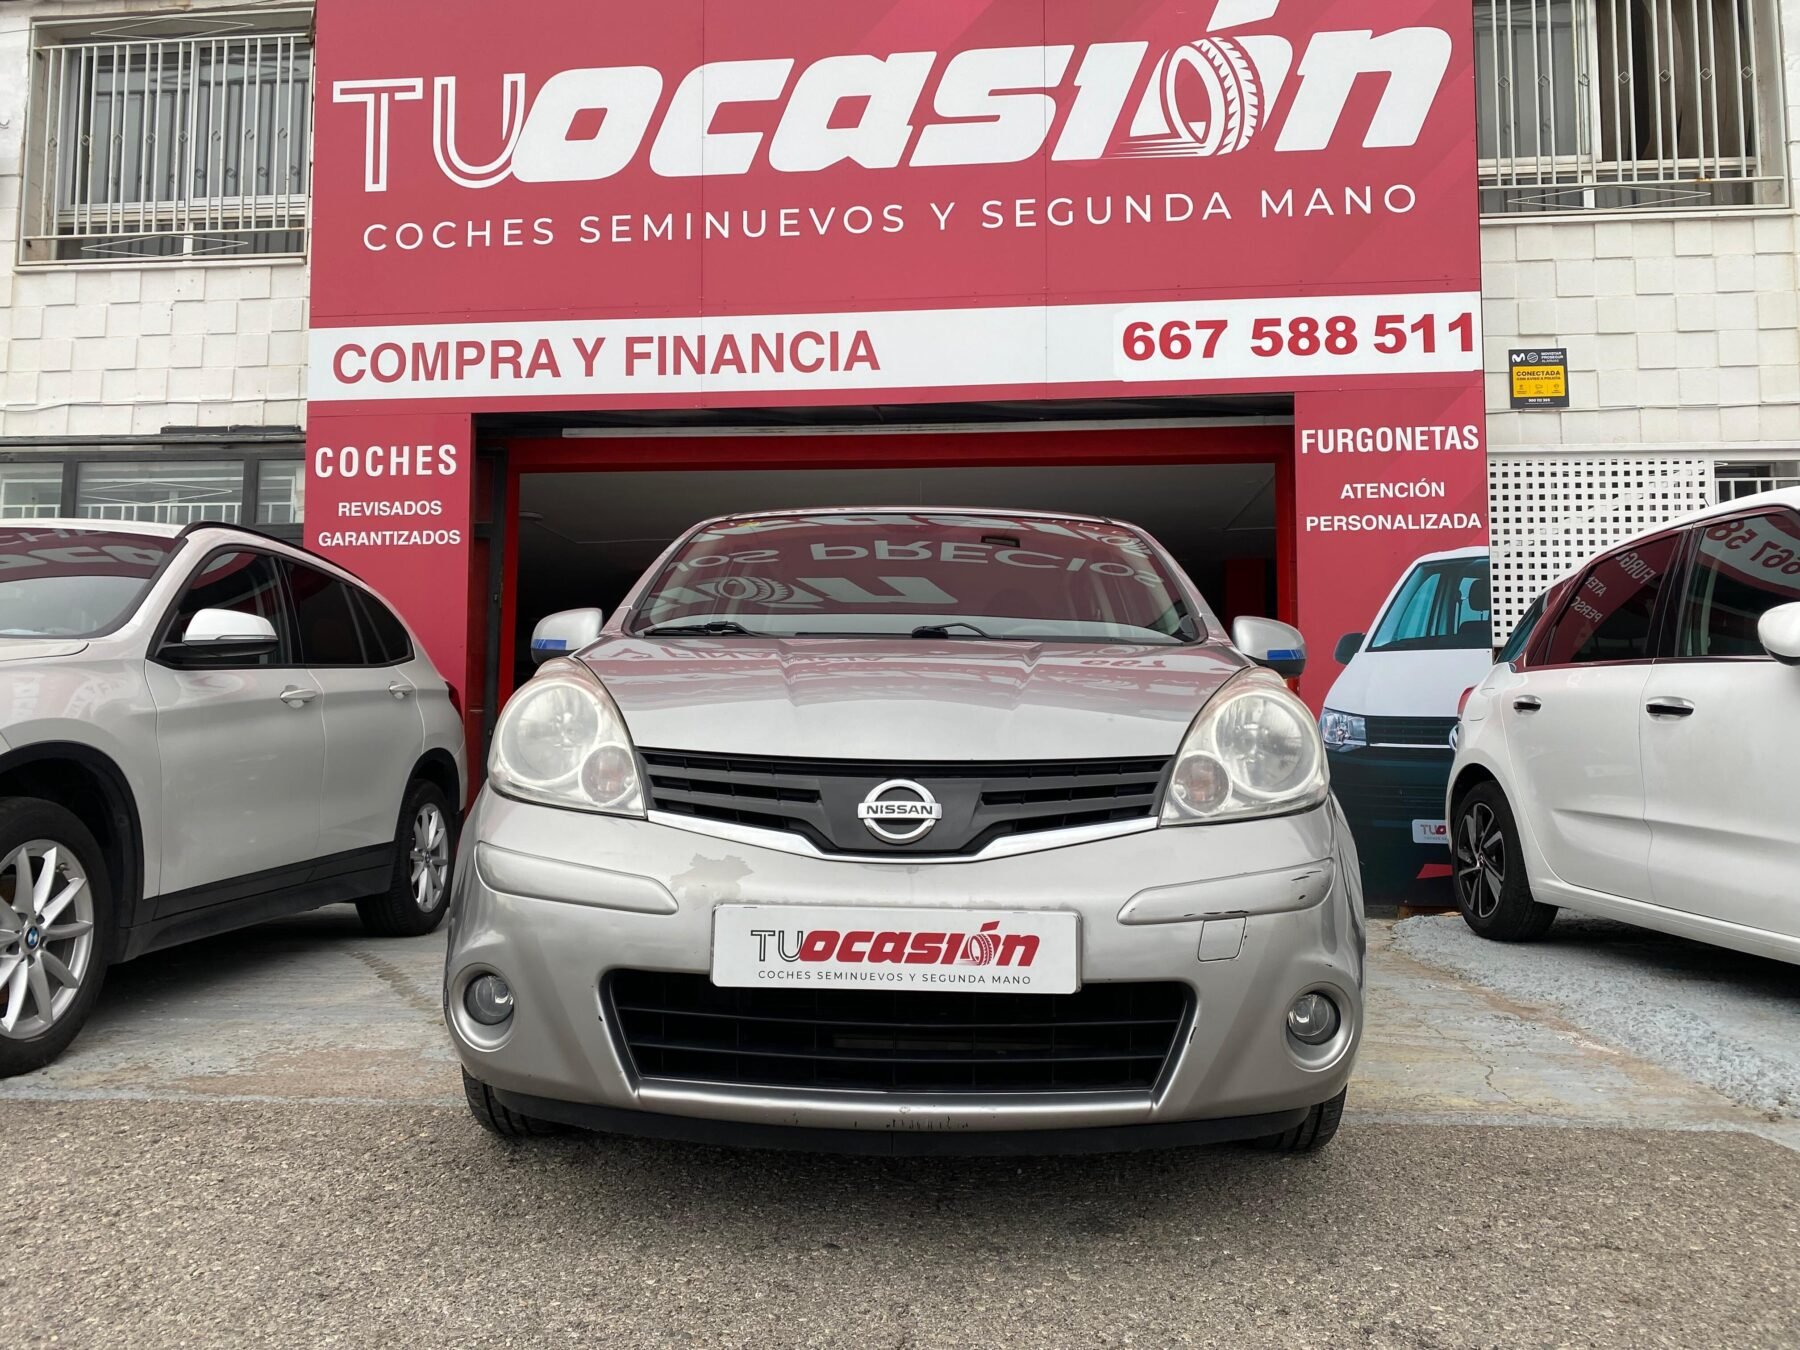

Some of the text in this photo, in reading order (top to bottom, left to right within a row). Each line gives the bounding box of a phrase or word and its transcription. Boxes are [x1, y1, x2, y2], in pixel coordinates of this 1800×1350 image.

[363, 183, 1417, 252] COCHES SEMINUEVOS Y SEGUNDA MANO
[1122, 312, 1474, 361] 667 588 511
[333, 330, 880, 385] COMPRA Y FINANCIA
[1301, 425, 1479, 454] FURGONETAS
[315, 444, 457, 478] COCHES
[1340, 478, 1445, 499] ATENCIÓN
[338, 500, 442, 516] REVISADOS
[1306, 513, 1482, 531] PERSONALIZADA
[318, 530, 461, 546] GARANTIZADOS
[866, 804, 934, 815] NISSAN
[758, 970, 1031, 985] COCHES SEMINUEVOS Y SEGUNDA MANO
